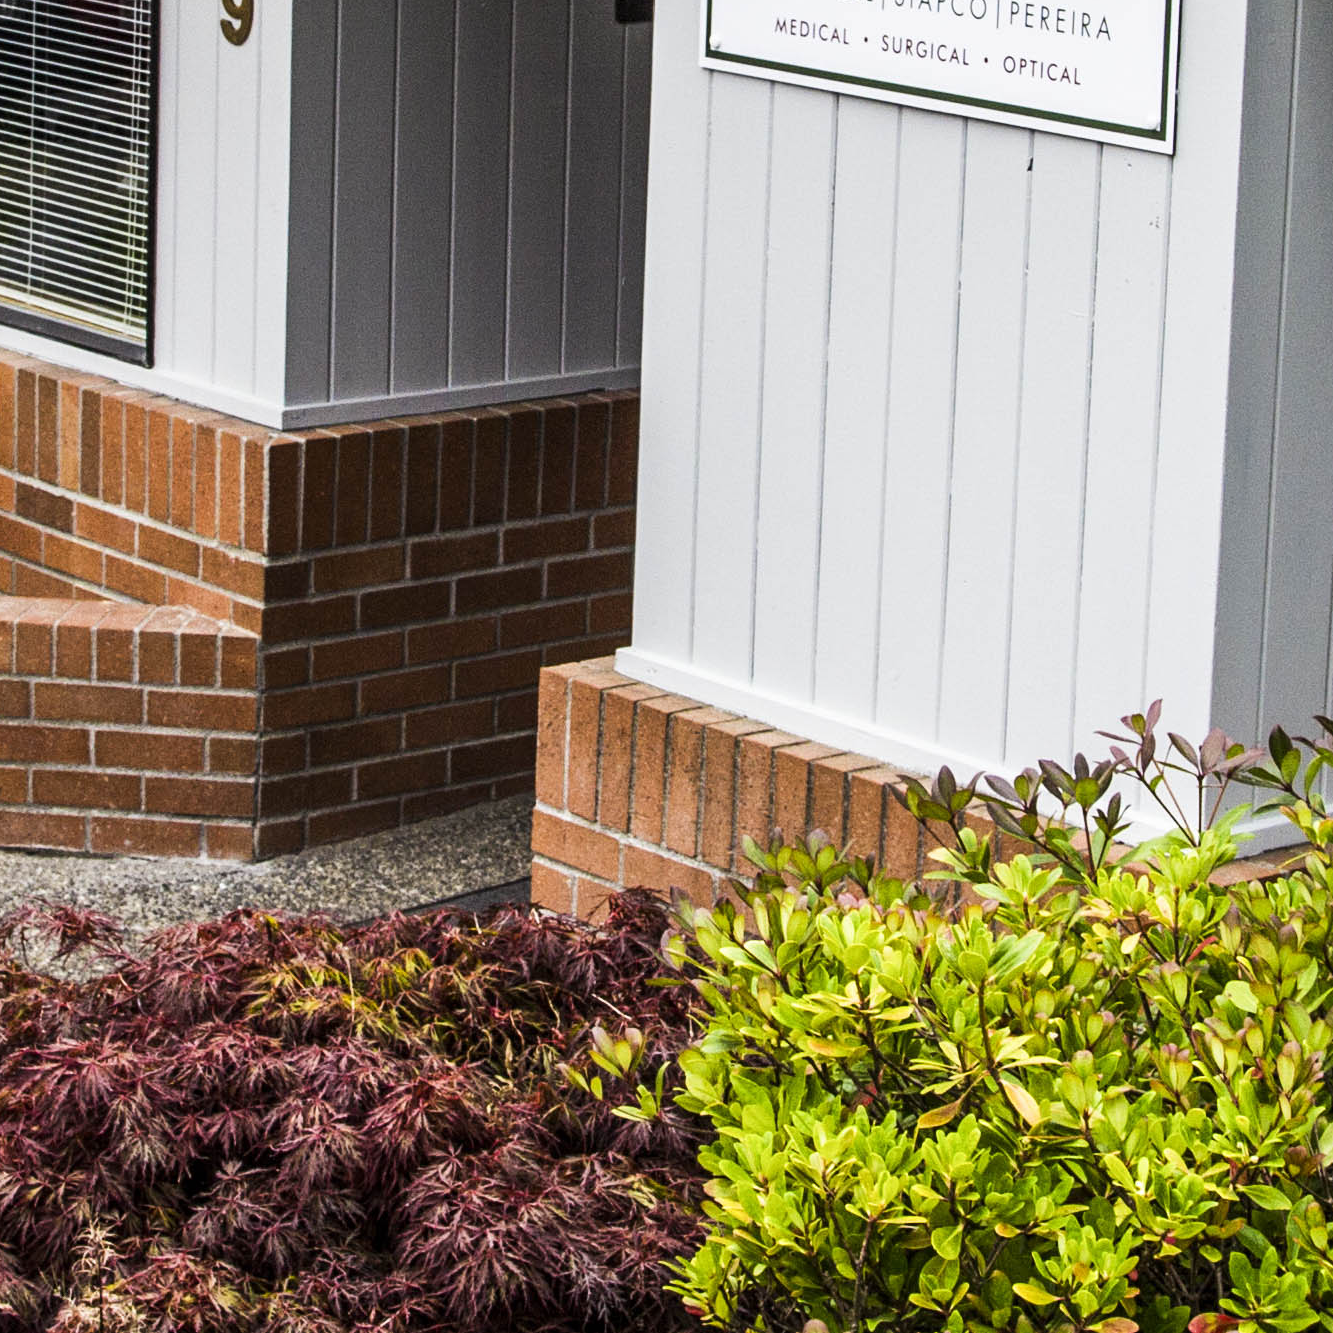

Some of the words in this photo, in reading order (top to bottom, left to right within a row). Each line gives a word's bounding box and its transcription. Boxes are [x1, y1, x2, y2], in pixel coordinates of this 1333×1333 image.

[774, 18, 851, 46] MEDICAL
[880, 34, 971, 67] SURGICAL
[1002, 55, 1082, 86] OPTICAL
